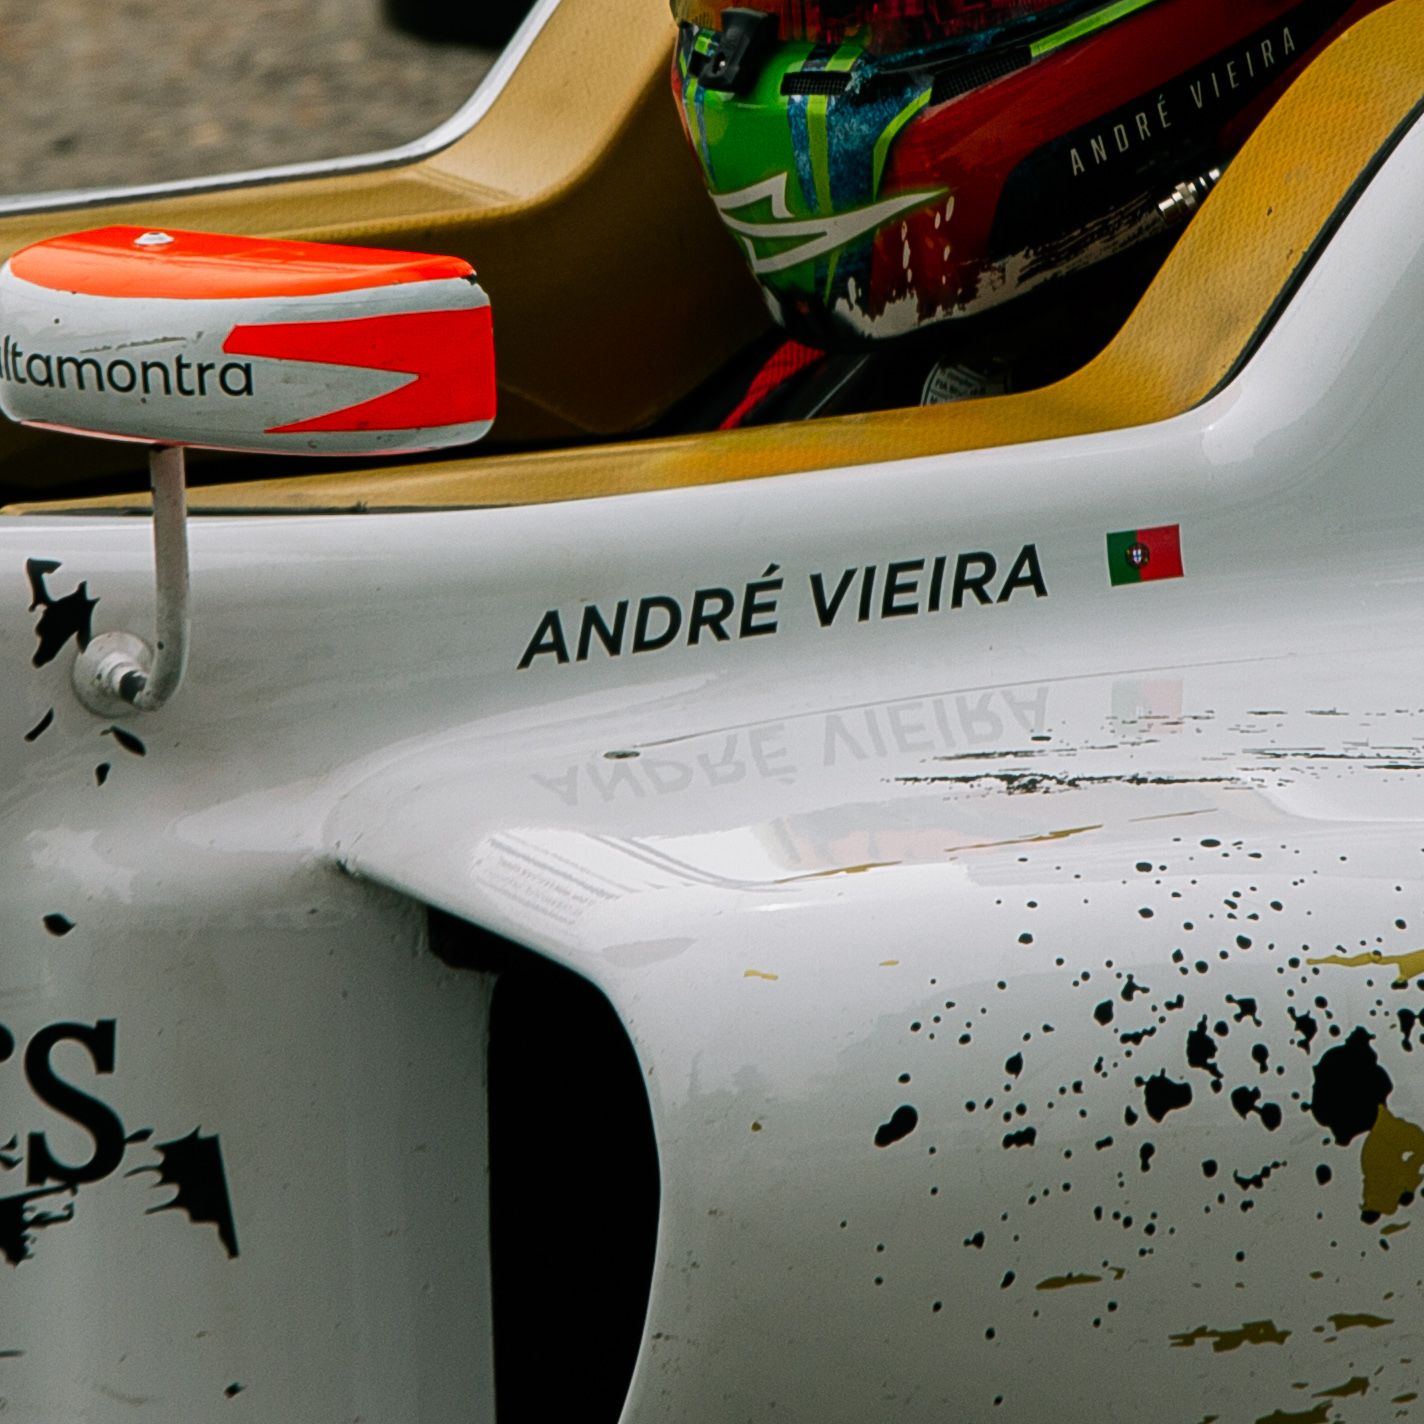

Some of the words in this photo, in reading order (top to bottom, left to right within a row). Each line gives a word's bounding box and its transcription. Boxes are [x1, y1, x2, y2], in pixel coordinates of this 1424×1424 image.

[1069, 93, 1172, 176] ANDRÉ
[1189, 26, 1296, 109] VIEIRA
[516, 563, 785, 670] ANDRÉ
[807, 543, 1048, 628] VIEIRA
